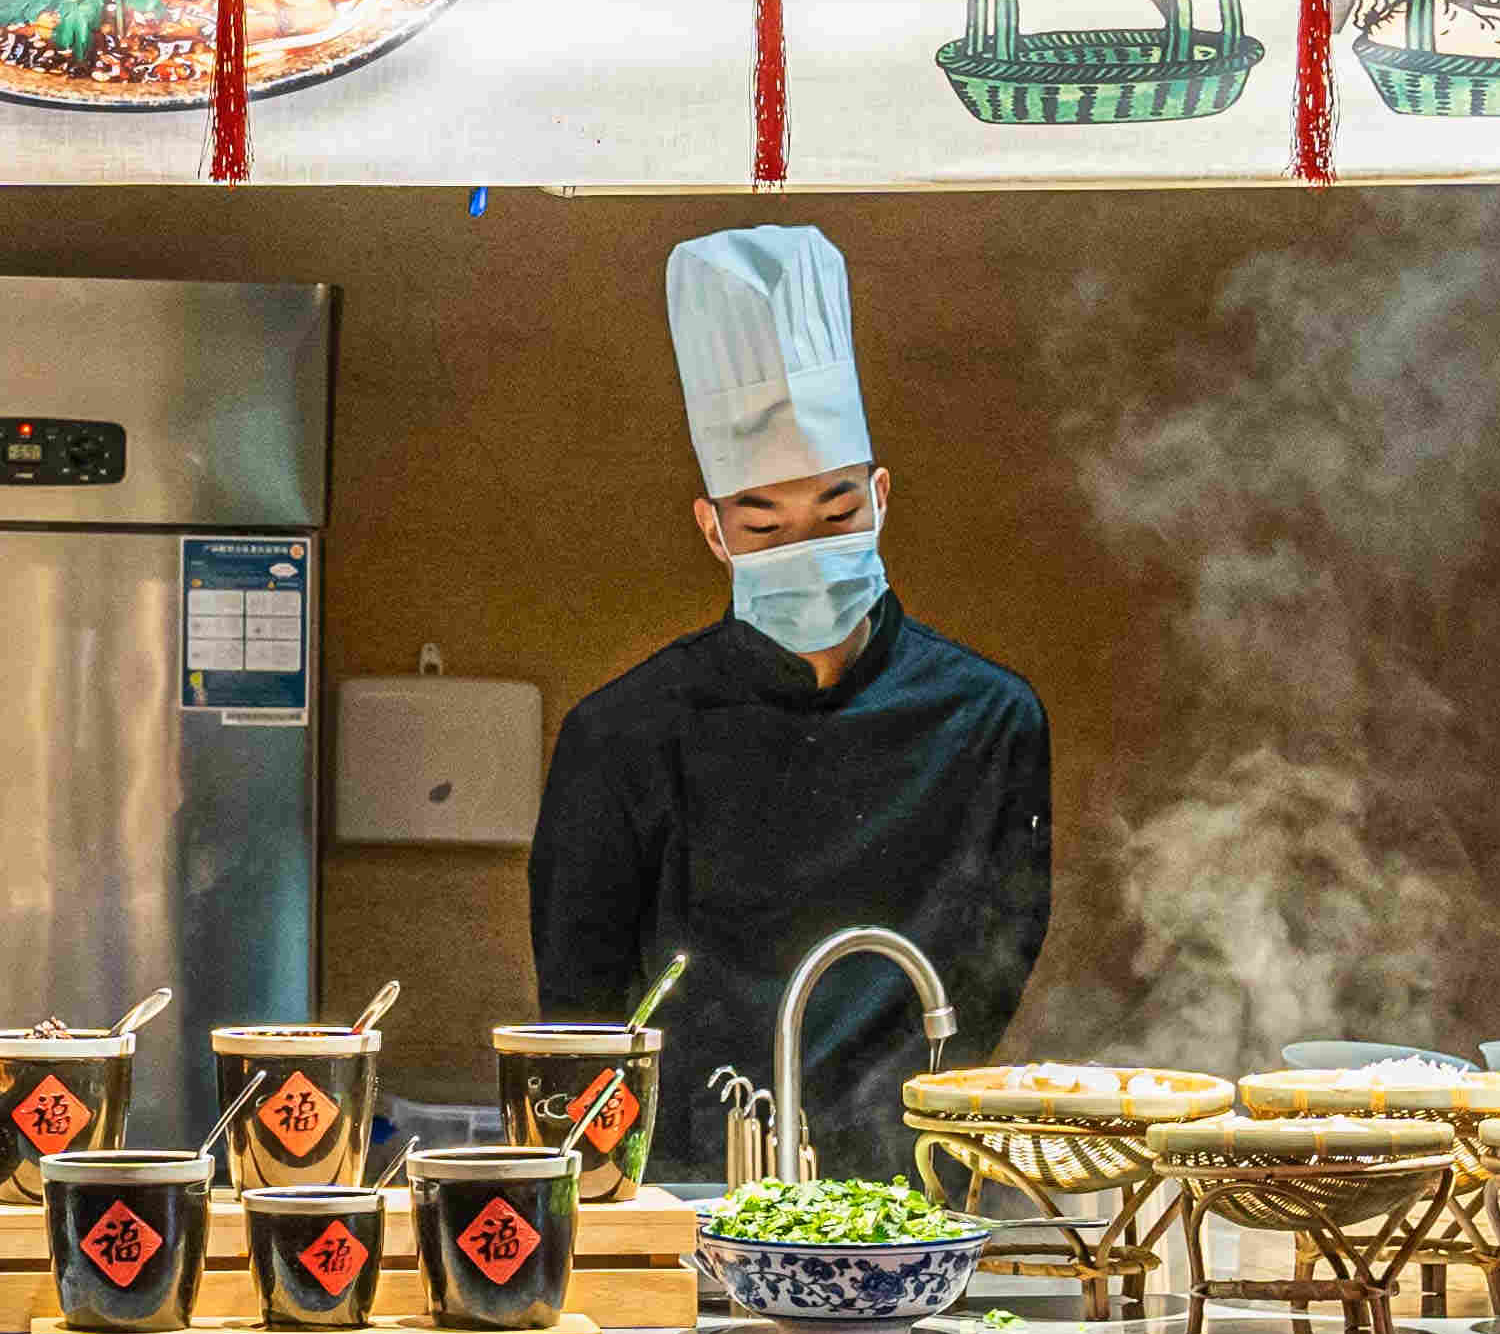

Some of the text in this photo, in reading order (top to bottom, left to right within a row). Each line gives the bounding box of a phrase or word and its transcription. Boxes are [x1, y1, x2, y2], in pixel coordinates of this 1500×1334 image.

[31, 1094, 71, 1136] 福
[273, 1090, 320, 1133] 福
[93, 1217, 142, 1265] 福
[312, 1236, 352, 1275] 福
[469, 1216, 521, 1263] 福
